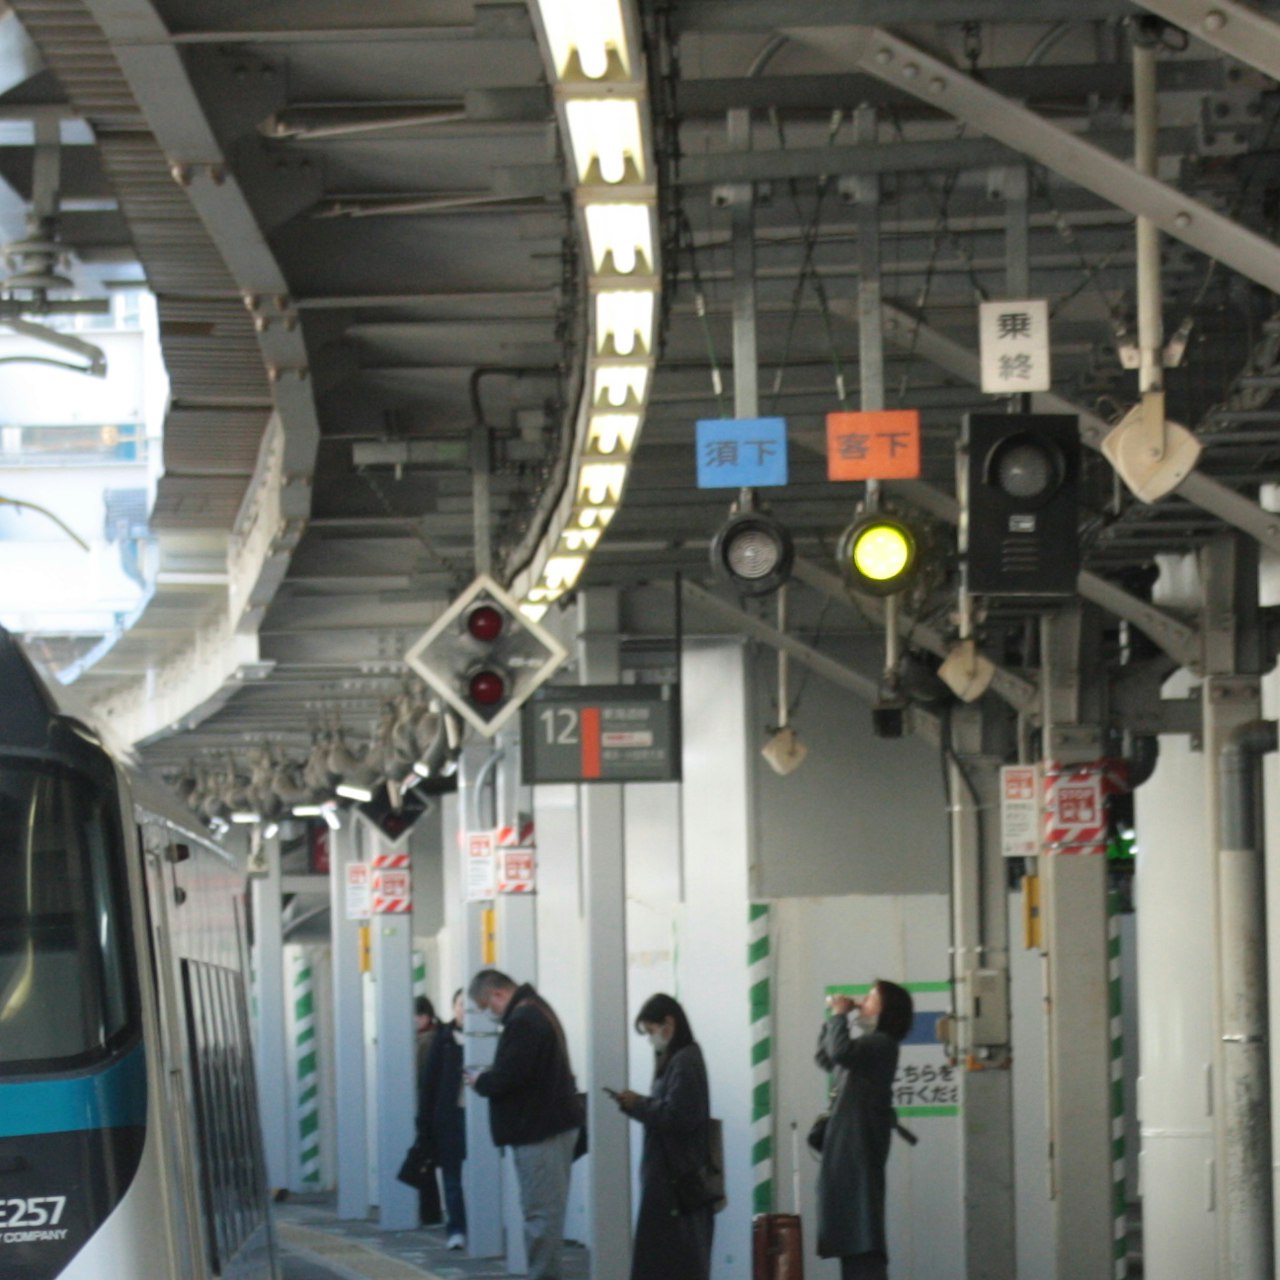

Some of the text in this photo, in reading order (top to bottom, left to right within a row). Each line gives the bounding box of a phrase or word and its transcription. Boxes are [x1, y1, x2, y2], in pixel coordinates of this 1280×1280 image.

[704, 437, 778, 469] 須下
[837, 431, 913, 461] 客下
[540, 706, 578, 745] 12
[4, 1229, 68, 1244] COMPANY
